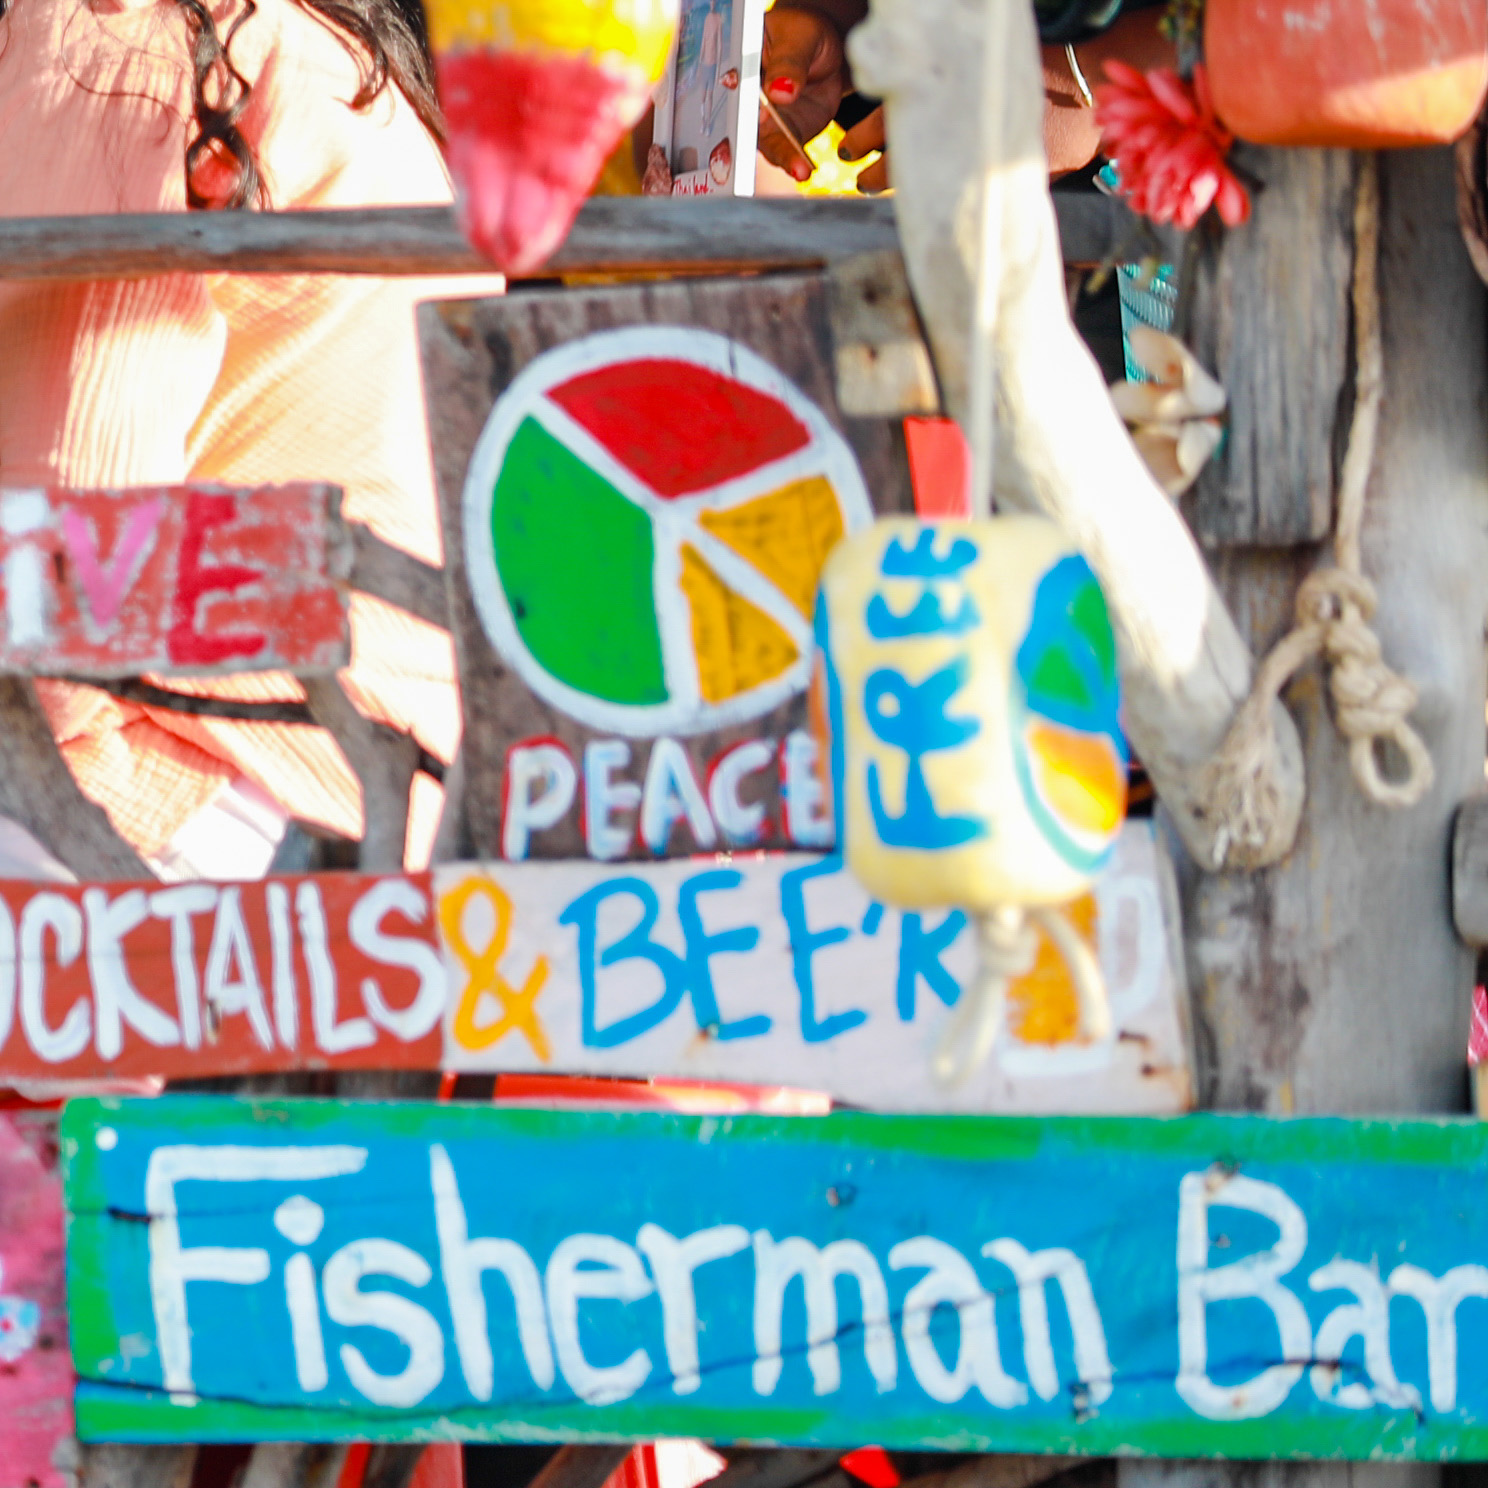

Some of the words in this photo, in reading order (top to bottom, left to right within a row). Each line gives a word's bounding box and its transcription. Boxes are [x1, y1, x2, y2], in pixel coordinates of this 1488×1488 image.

[502, 733, 836, 862] PEACE
[860, 526, 990, 852] FREE
[437, 874, 552, 1064] &
[146, 1144, 1108, 1405] Fisherman
[1176, 1167, 1488, 1419] Bar
